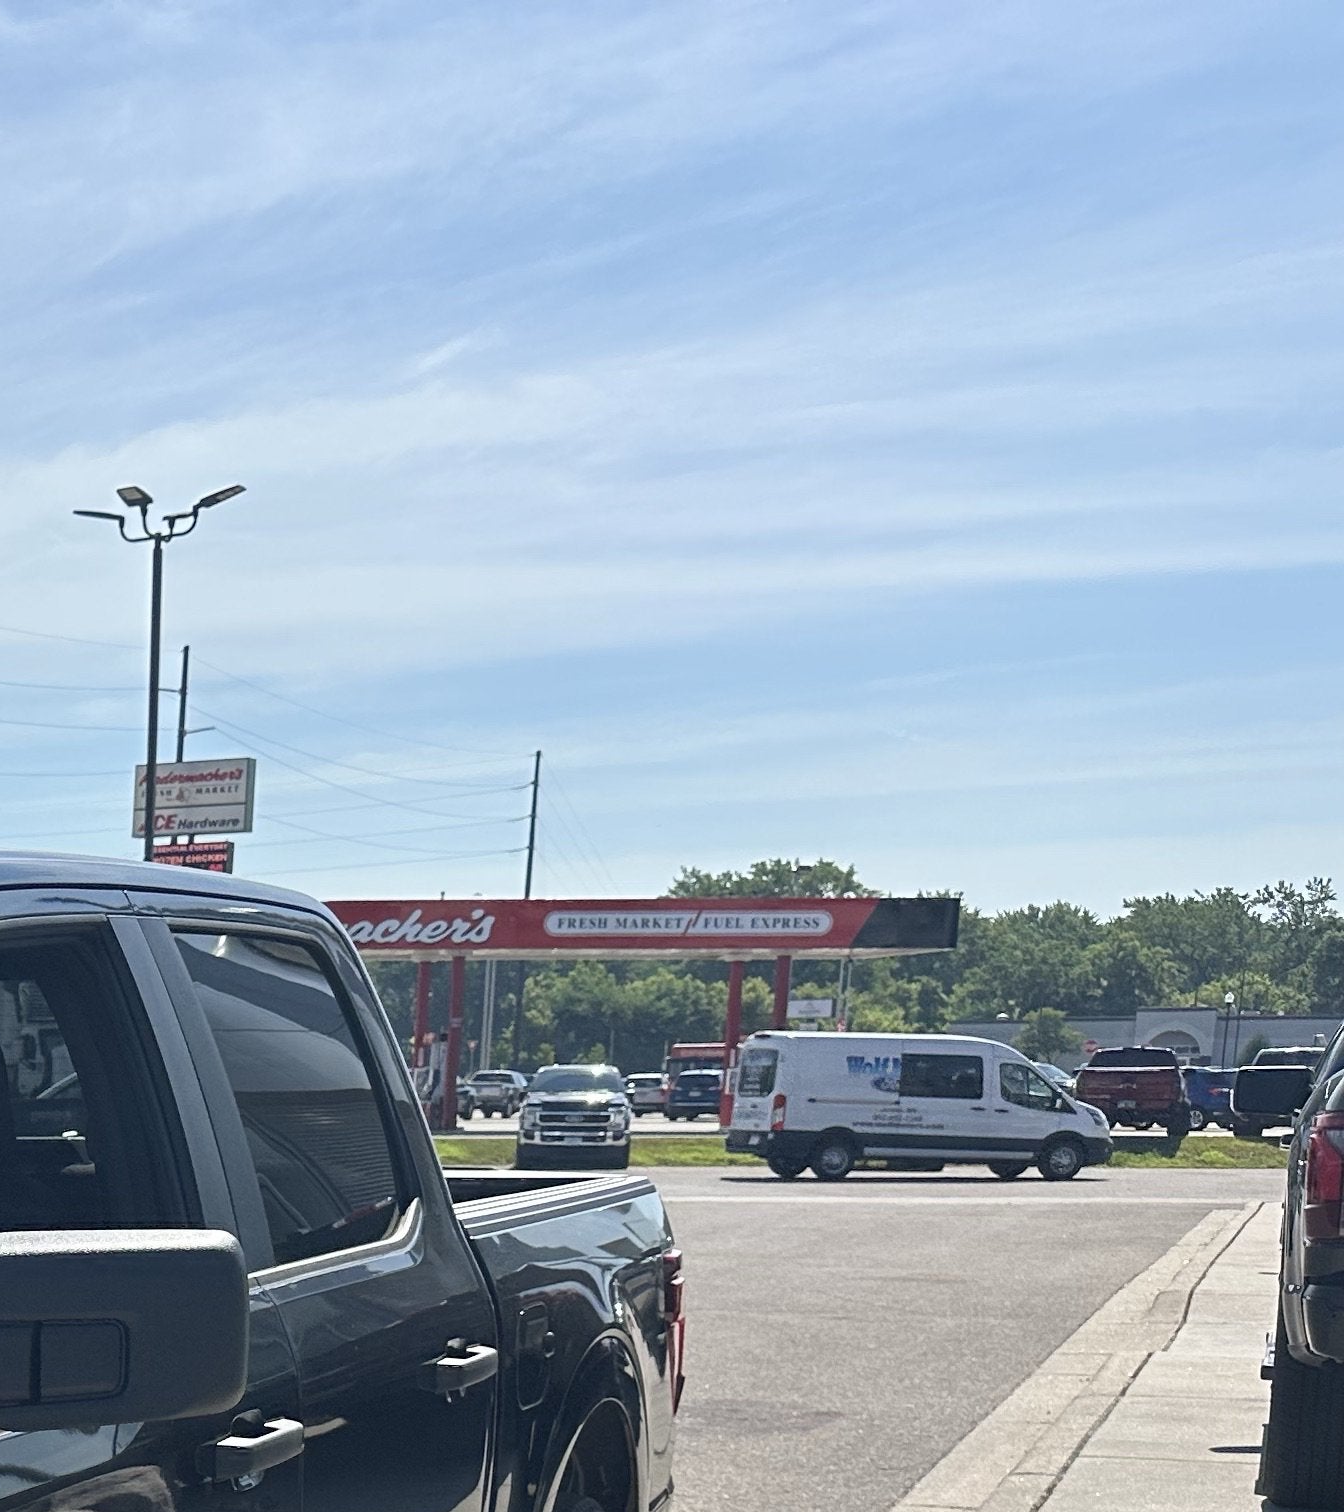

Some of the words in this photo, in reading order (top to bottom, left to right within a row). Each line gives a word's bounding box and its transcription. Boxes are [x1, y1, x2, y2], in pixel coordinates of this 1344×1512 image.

[177, 817, 241, 830] Hardware
[557, 917, 608, 929] FRESH
[615, 917, 684, 929] MARKET
[703, 917, 744, 929] FUEL
[750, 917, 821, 929] EXPRESS
